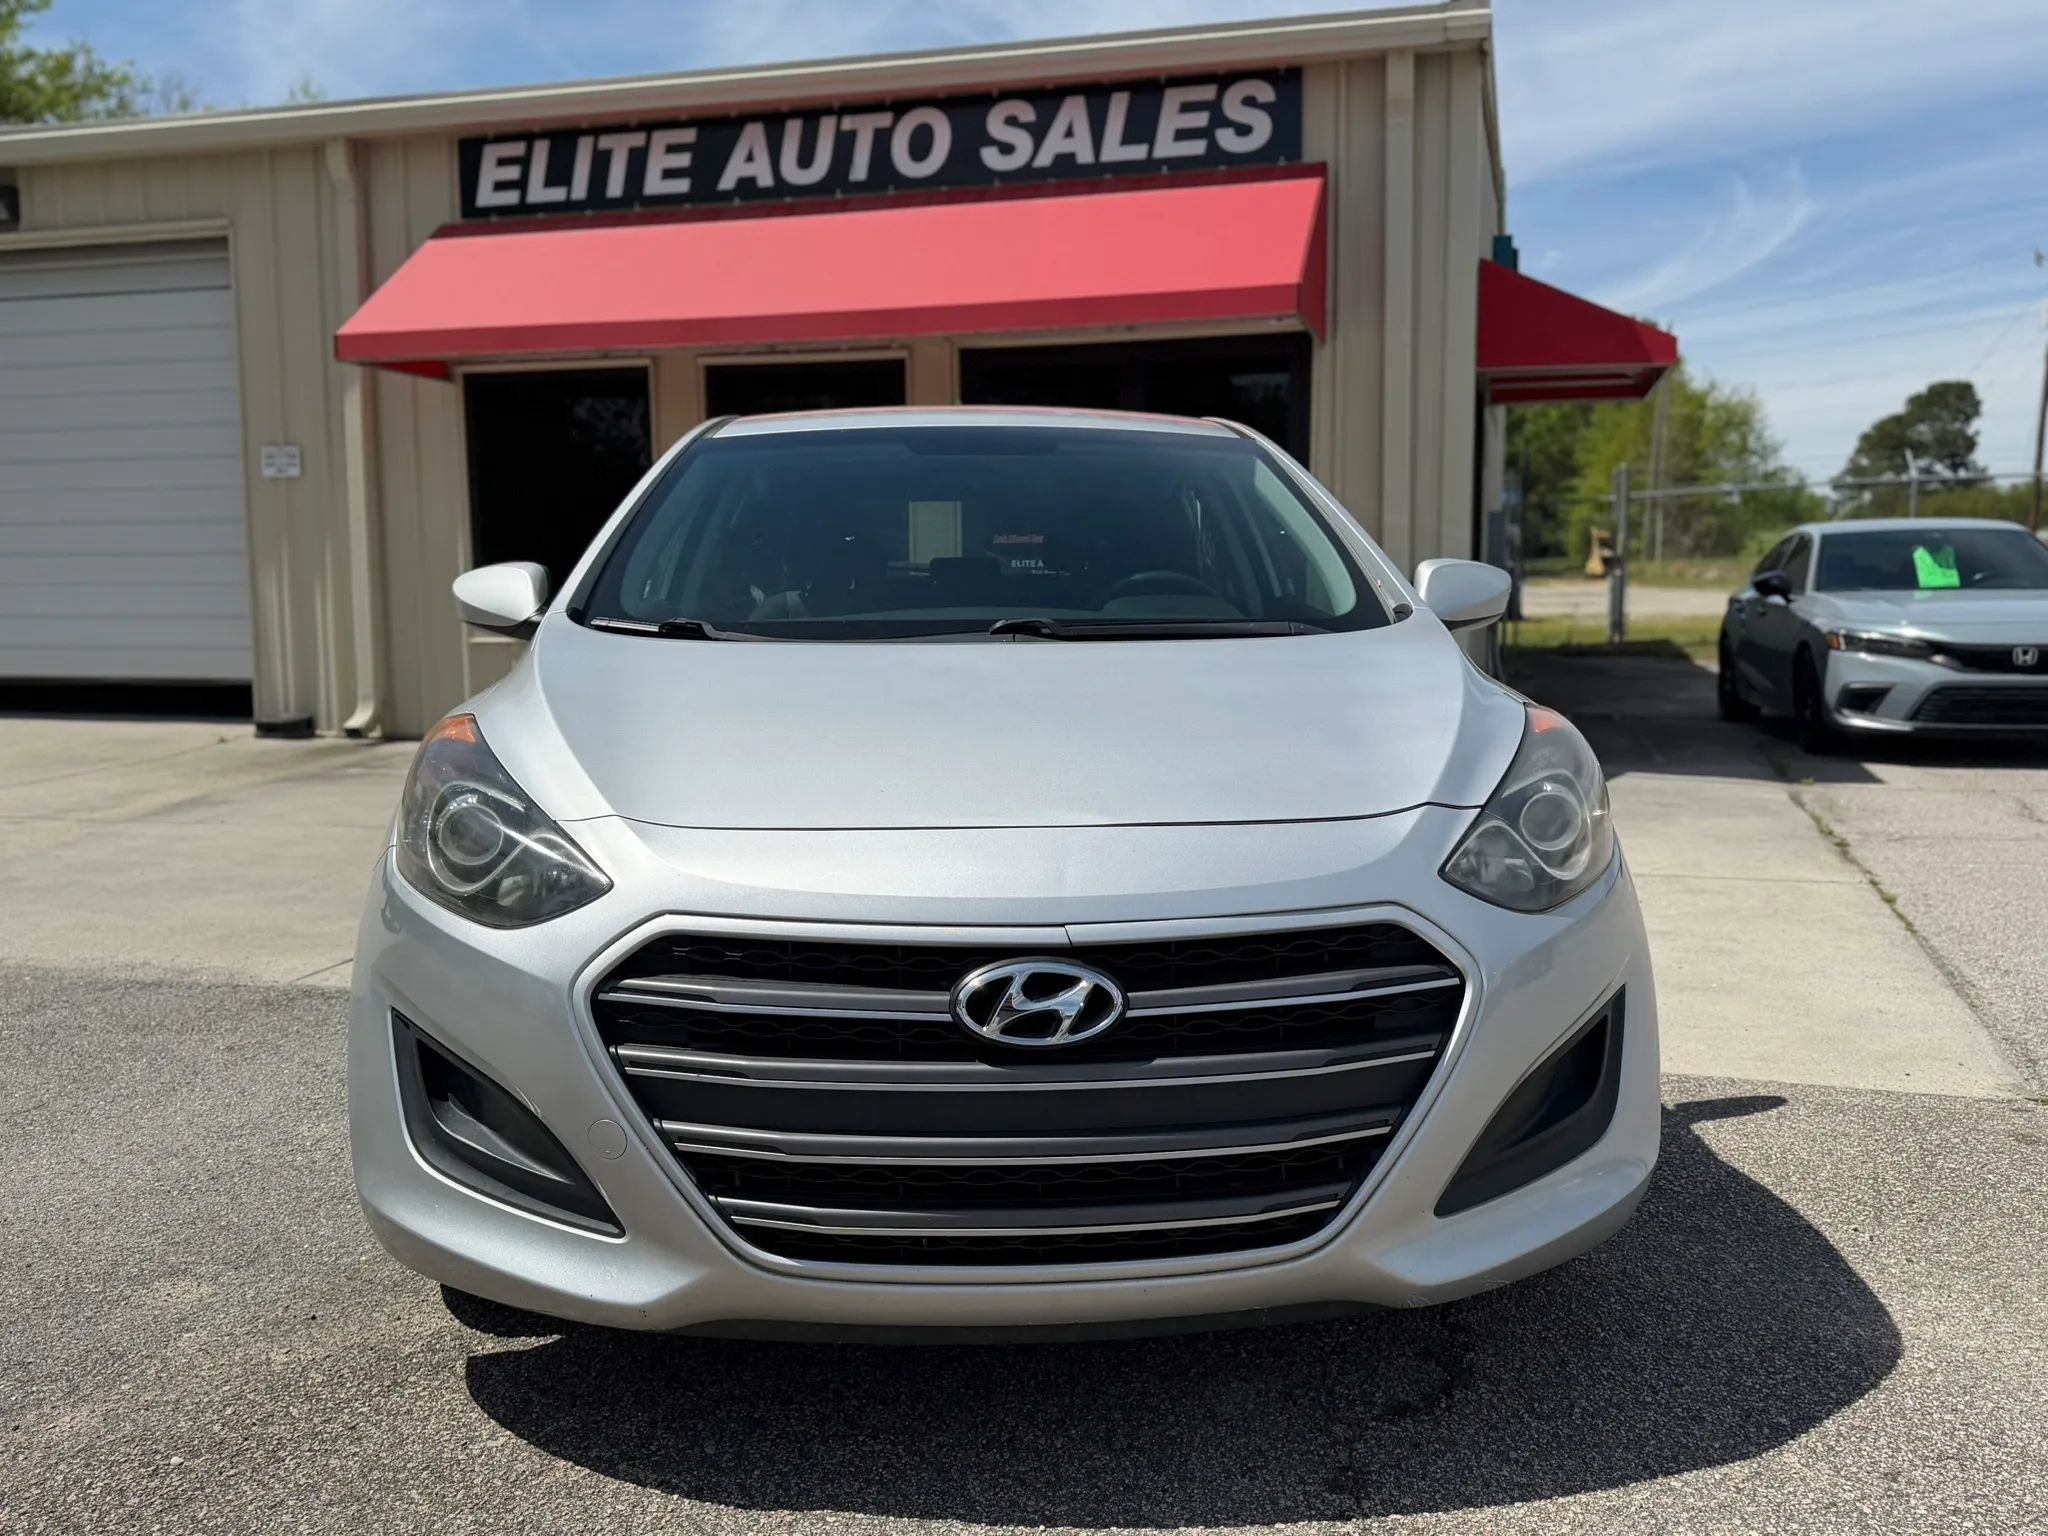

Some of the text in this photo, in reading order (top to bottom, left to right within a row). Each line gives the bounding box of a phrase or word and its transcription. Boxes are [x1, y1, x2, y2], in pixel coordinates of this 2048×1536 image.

[476, 81, 1277, 207] ELITE AUTO SALES
